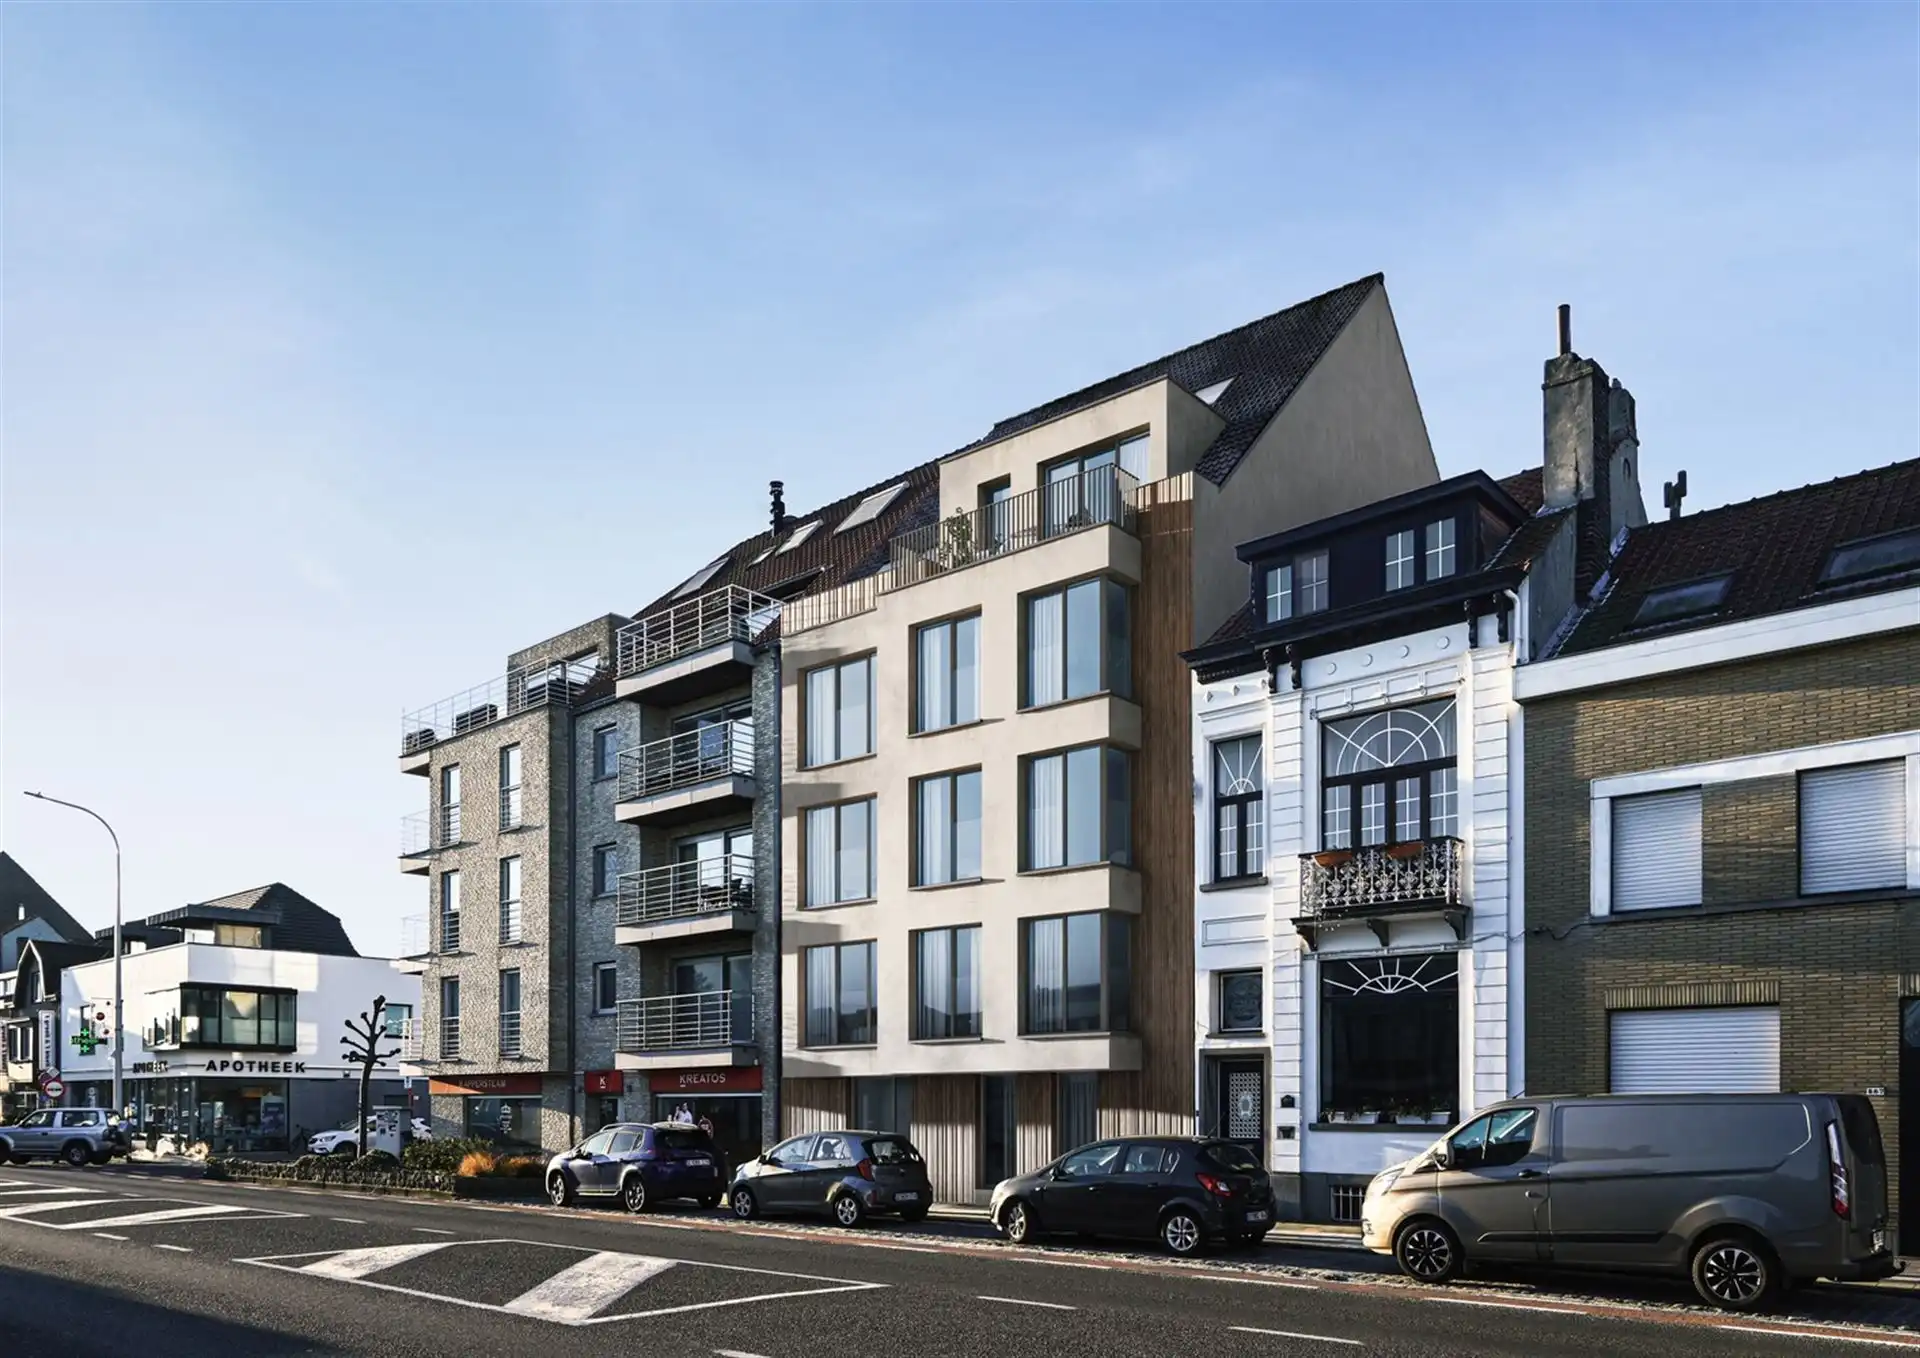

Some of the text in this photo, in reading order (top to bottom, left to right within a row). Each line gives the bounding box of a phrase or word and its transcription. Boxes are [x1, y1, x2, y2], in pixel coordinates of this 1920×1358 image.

[206, 1060, 305, 1073] APOTHEEK
[599, 1076, 606, 1086] K
[679, 1073, 726, 1084] KREATOS
